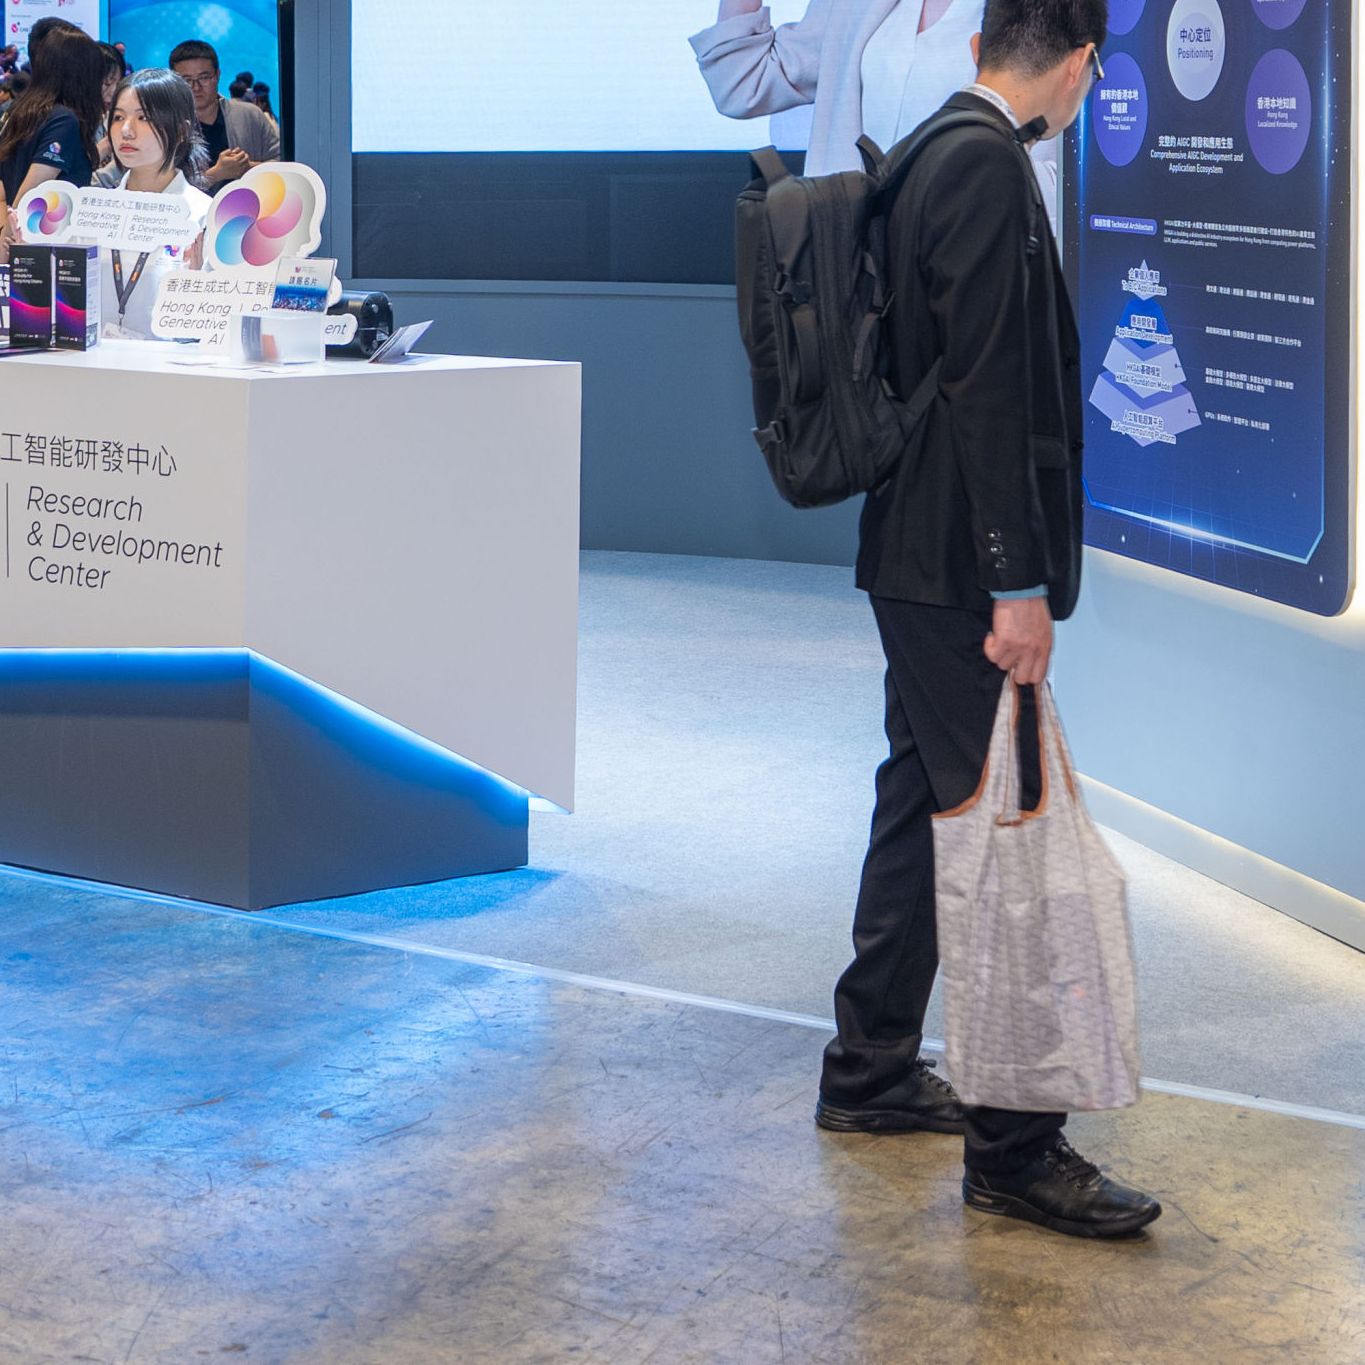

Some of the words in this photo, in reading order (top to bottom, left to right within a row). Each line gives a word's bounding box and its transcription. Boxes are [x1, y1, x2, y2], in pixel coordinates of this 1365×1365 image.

[1179, 27, 1212, 43] 中心定位
[1177, 47, 1214, 61] Positioning
[1150, 149, 1187, 161] Comprehensive
[1200, 151, 1233, 163] Development
[1233, 153, 1244, 163] and
[1168, 163, 1196, 174] Application
[1196, 164, 1224, 176] Ecosystem
[77, 210, 98, 221] Hong
[100, 211, 121, 222] Kong
[131, 215, 168, 225] Research
[77, 219, 119, 231] Generative
[137, 225, 190, 236] Development
[127, 234, 155, 242] Center
[161, 300, 193, 315] Hong
[196, 301, 232, 318] Kong
[159, 315, 228, 331] Generative
[207, 334, 224, 345] AI
[27, 485, 143, 522] Research
[27, 520, 43, 547] &
[52, 523, 223, 568] Development
[28, 556, 111, 589] Center
